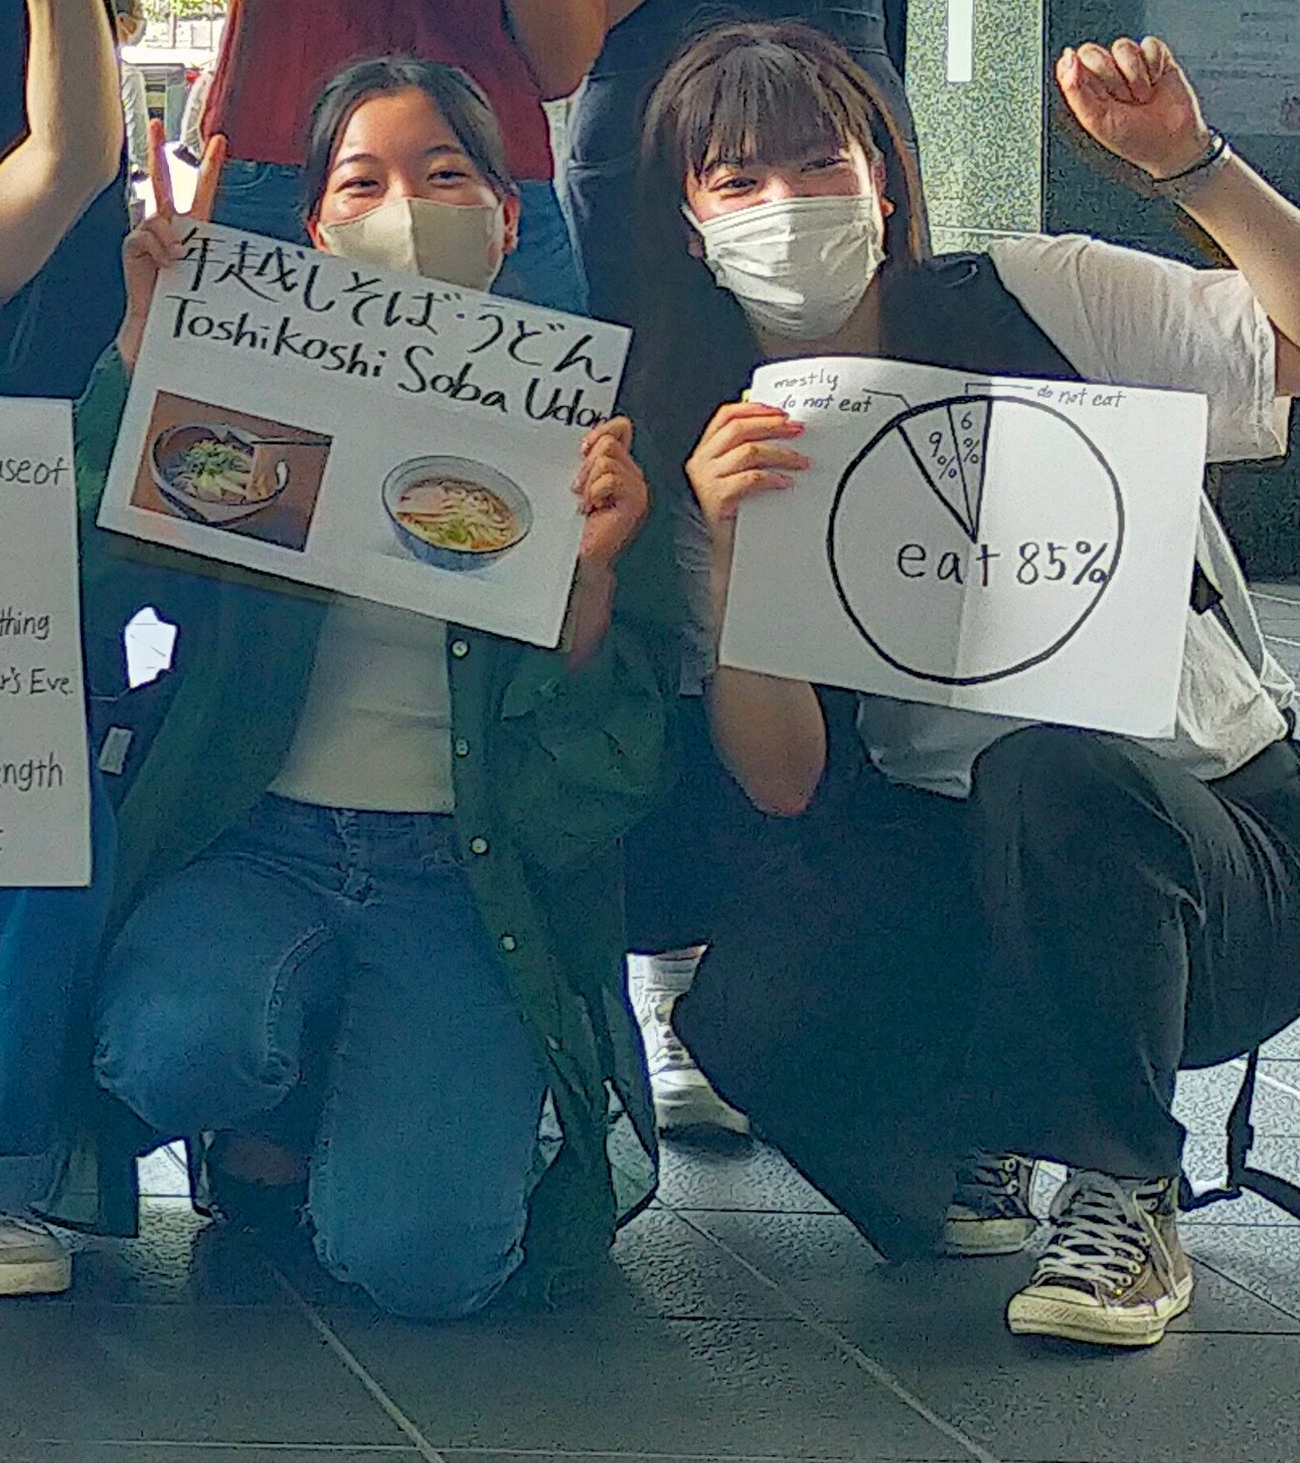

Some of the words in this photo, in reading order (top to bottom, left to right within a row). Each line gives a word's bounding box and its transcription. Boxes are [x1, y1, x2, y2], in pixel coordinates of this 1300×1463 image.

[165, 294, 388, 379] Toshikoshi
[397, 346, 508, 413] Soba
[803, 394, 835, 409] not
[839, 395, 873, 413] eat
[1037, 386, 1054, 398] do
[1058, 391, 1088, 406] not
[1092, 391, 1126, 408] eat
[896, 541, 1000, 587] eat
[1016, 540, 1110, 586] 85%
